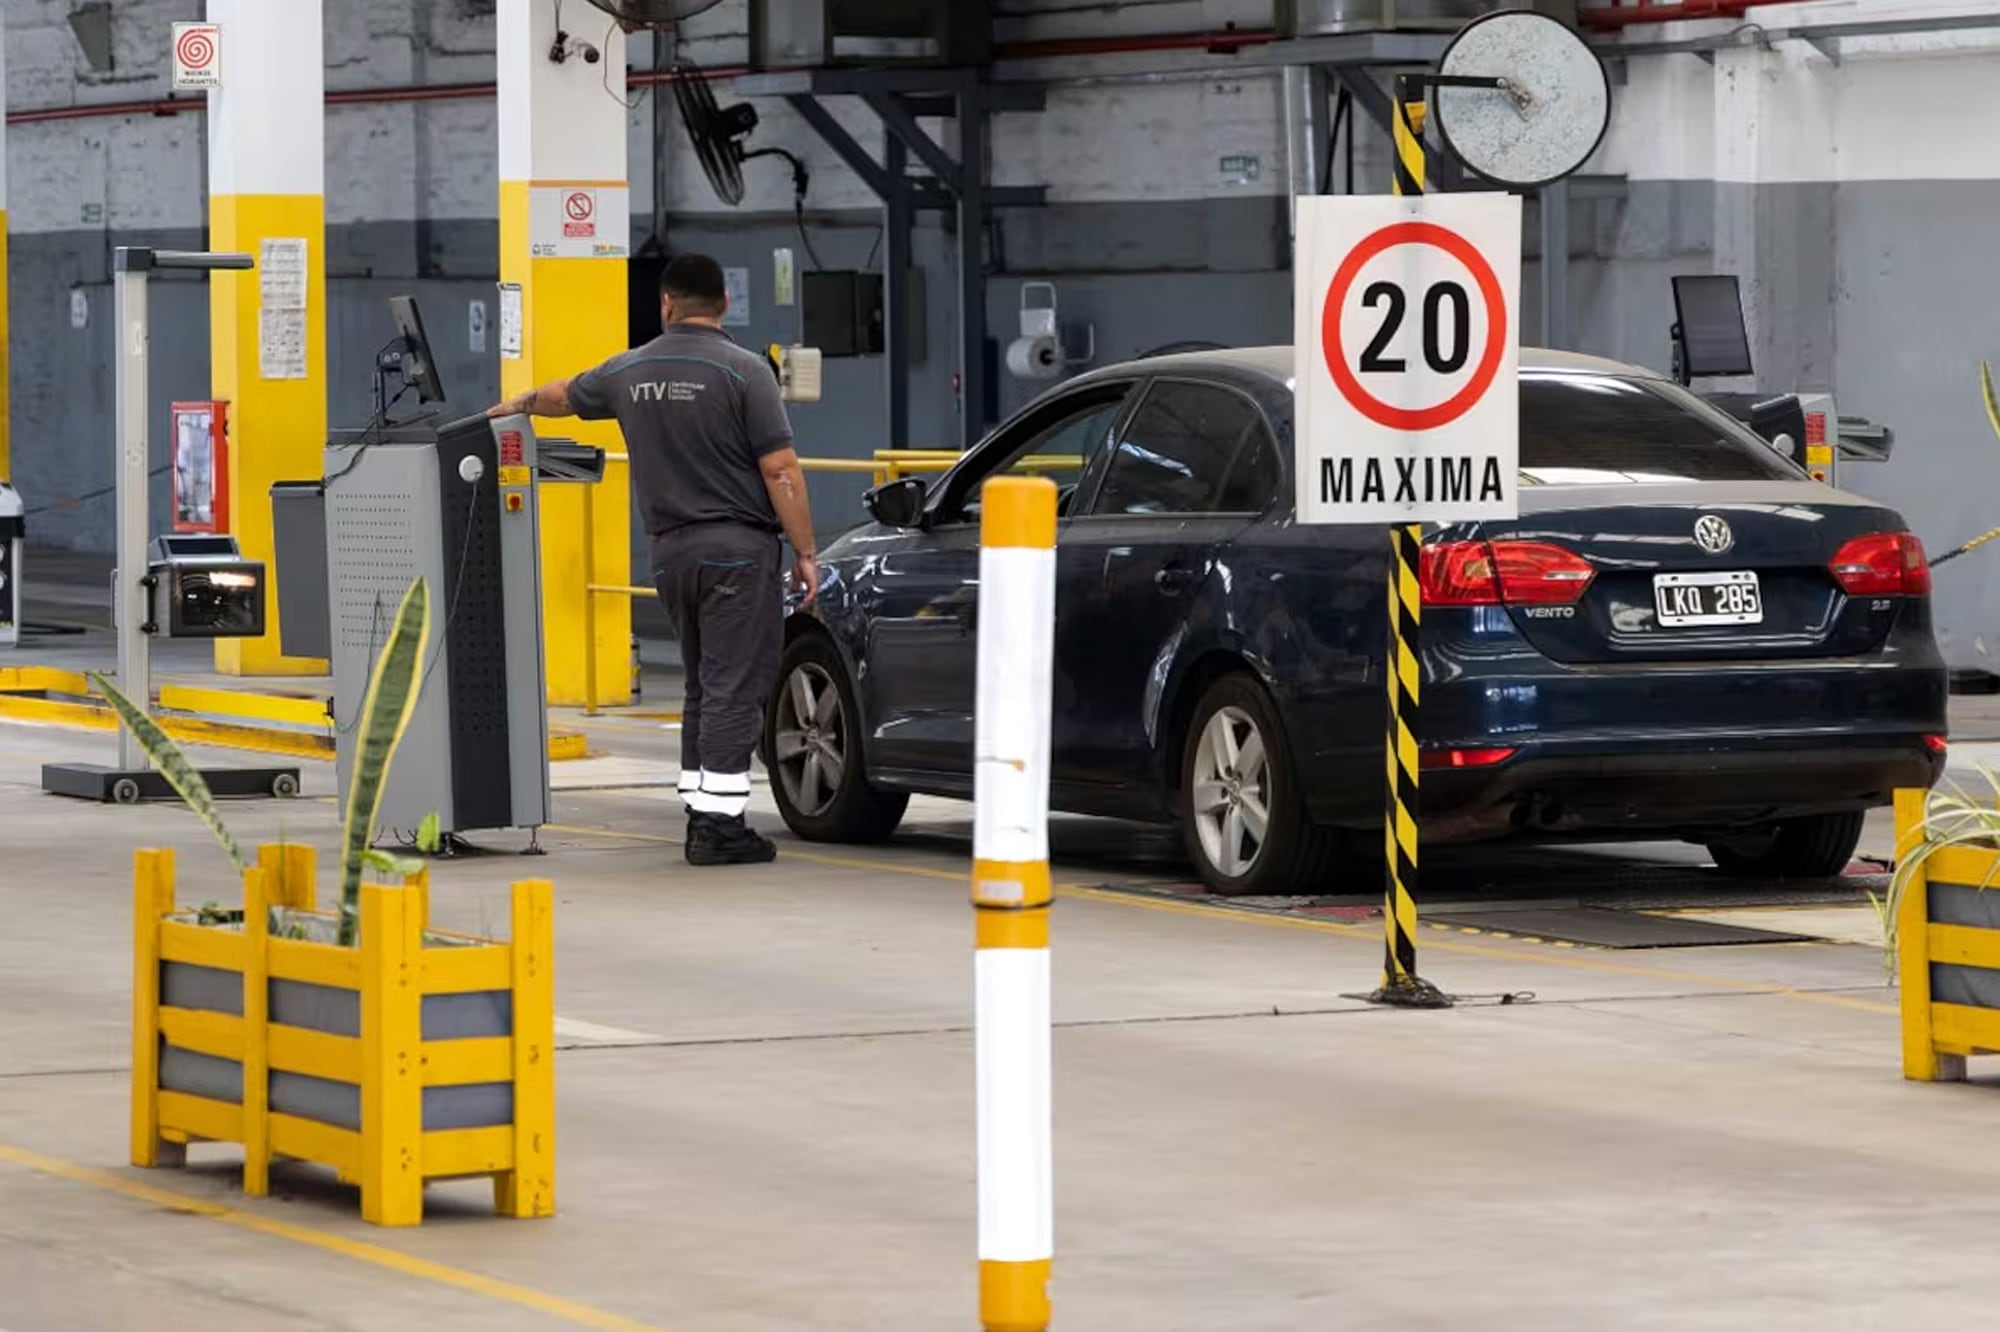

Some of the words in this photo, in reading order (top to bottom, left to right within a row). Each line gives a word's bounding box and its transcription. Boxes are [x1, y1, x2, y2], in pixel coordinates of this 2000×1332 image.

[1359, 280, 1469, 375] 20
[629, 381, 666, 403] VTV
[1320, 456, 1504, 503] MAXIMA
[1524, 607, 1575, 618] VENTO
[1659, 586, 1704, 615] LKQ
[1713, 584, 1757, 613] 285
